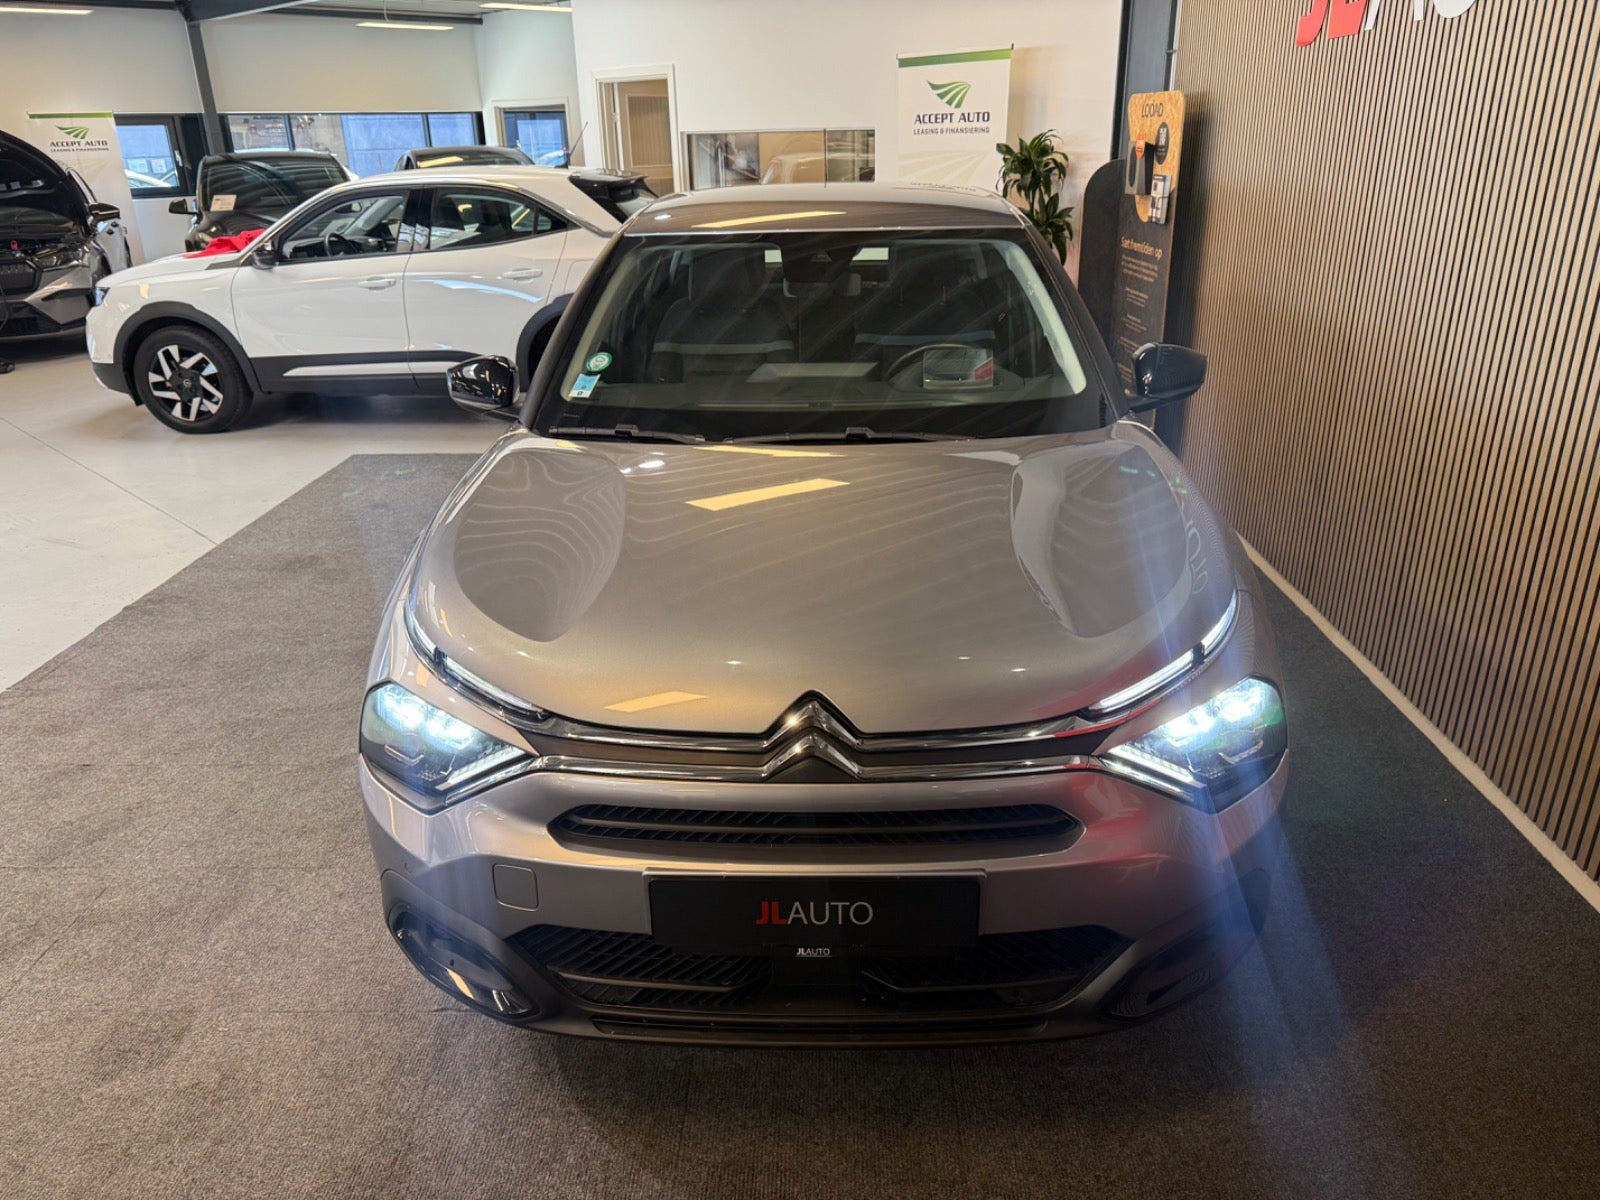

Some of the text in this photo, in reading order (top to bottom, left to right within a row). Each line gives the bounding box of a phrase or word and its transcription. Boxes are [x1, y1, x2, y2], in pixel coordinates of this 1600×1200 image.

[914, 111, 991, 125] ACCEPT AUTO
[913, 127, 939, 136] LEASING
[945, 126, 990, 135] FINANSIERING
[755, 901, 874, 926] JLAUTO
[796, 947, 831, 956] JLAUTO
